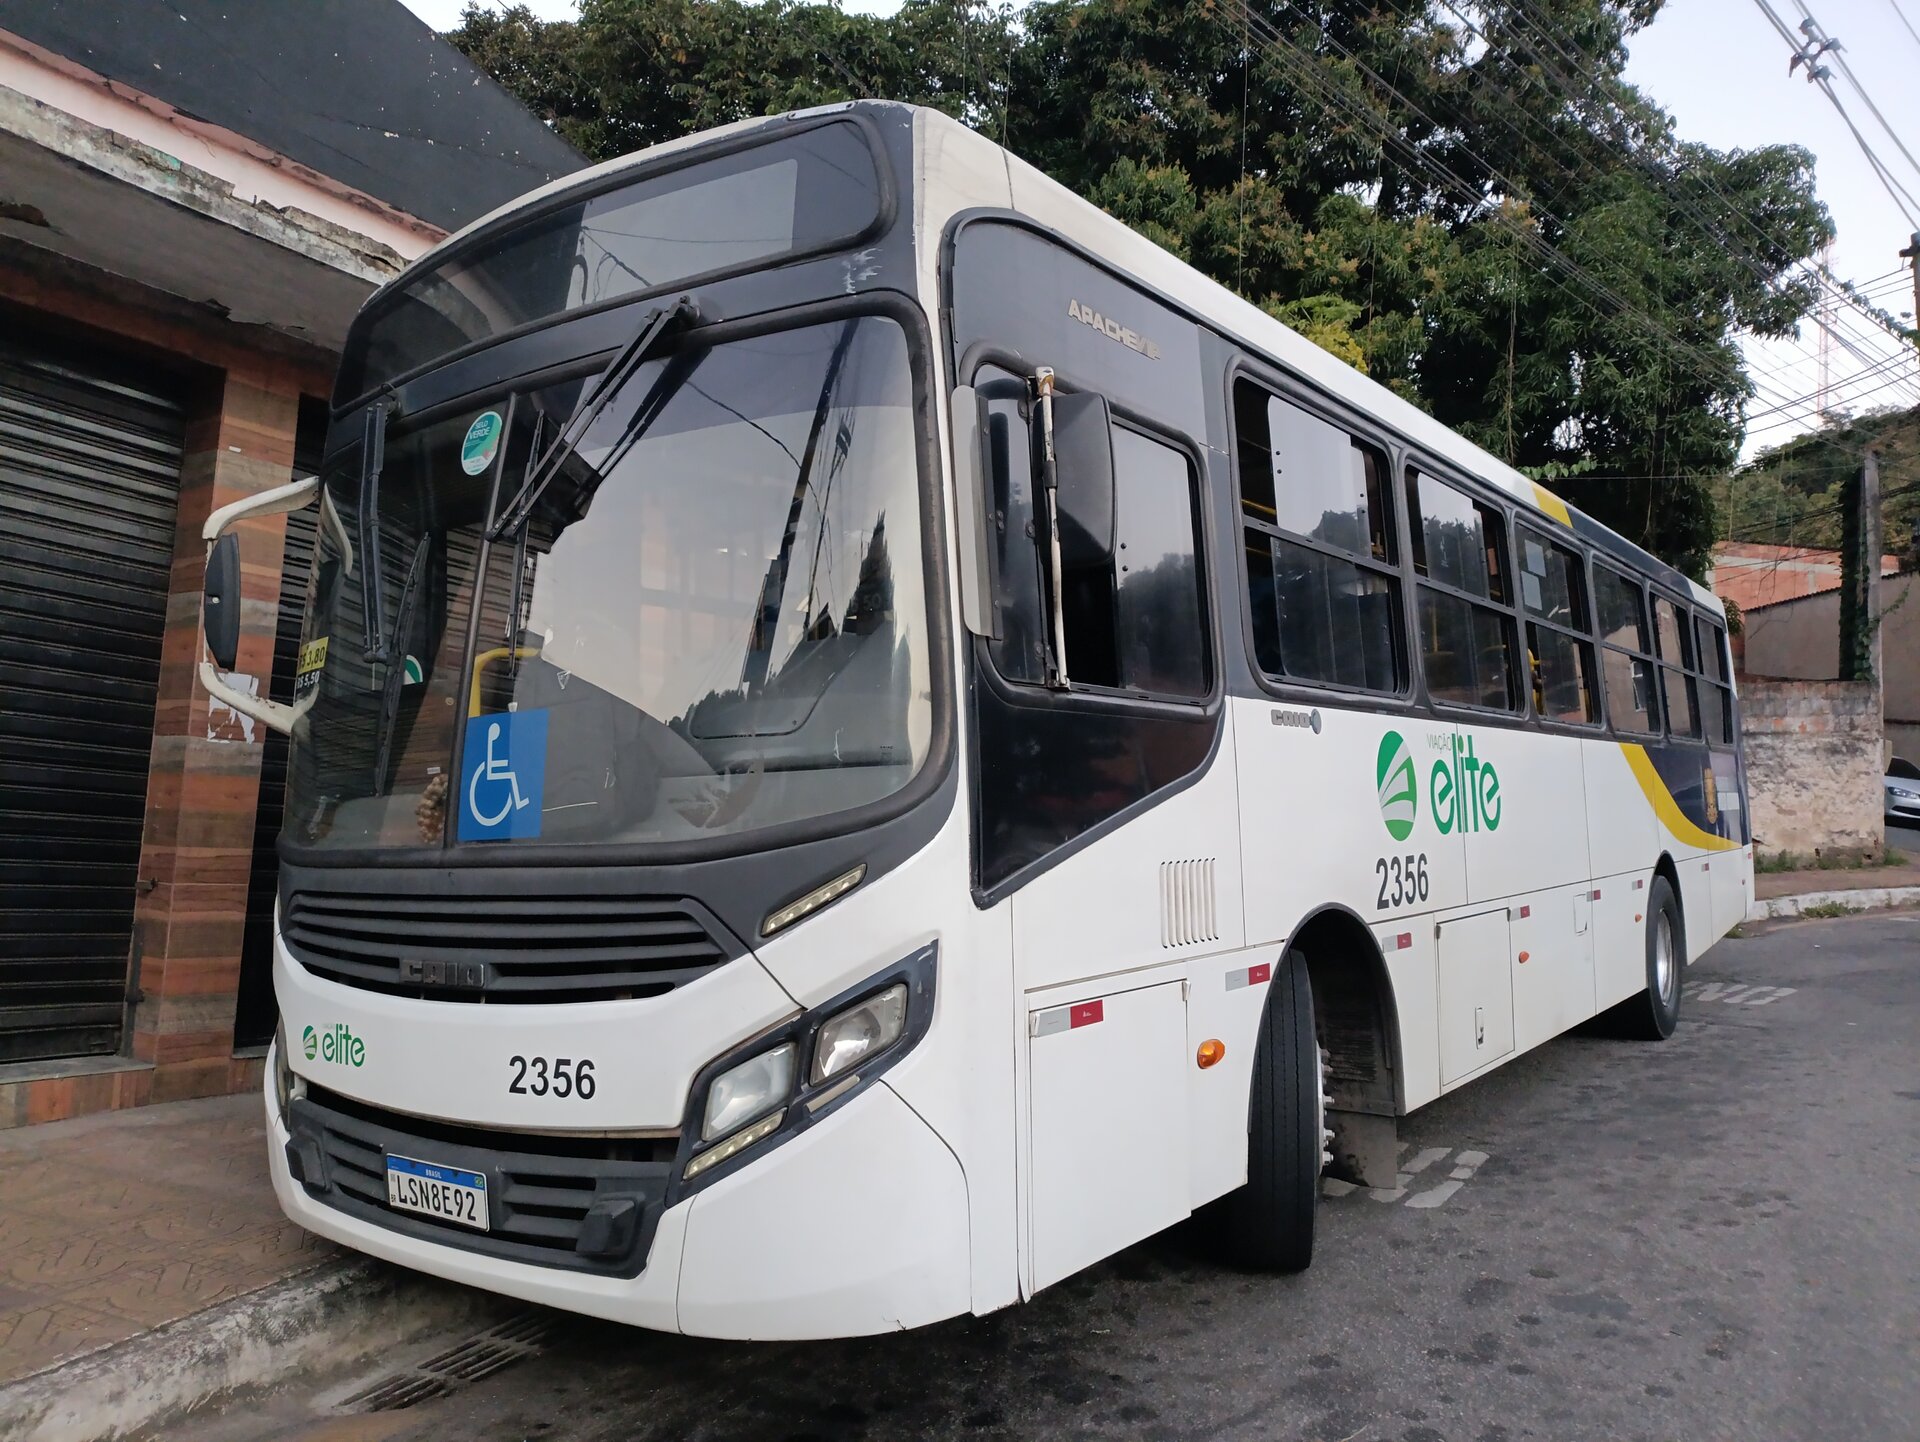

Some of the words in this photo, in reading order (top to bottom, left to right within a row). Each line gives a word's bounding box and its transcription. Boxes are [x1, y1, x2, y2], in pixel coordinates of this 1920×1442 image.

[303, 669, 320, 688] 5,50
[306, 645, 326, 669] 3,80
[1426, 731, 1453, 754] VIAÇÃO
[1429, 732, 1502, 836] elite
[1375, 852, 1429, 911] 2356
[322, 1023, 366, 1068] elite
[508, 1055, 596, 1101] 2356
[425, 1168, 443, 1180] BRASIL
[396, 1174, 477, 1222] LSN8E92
